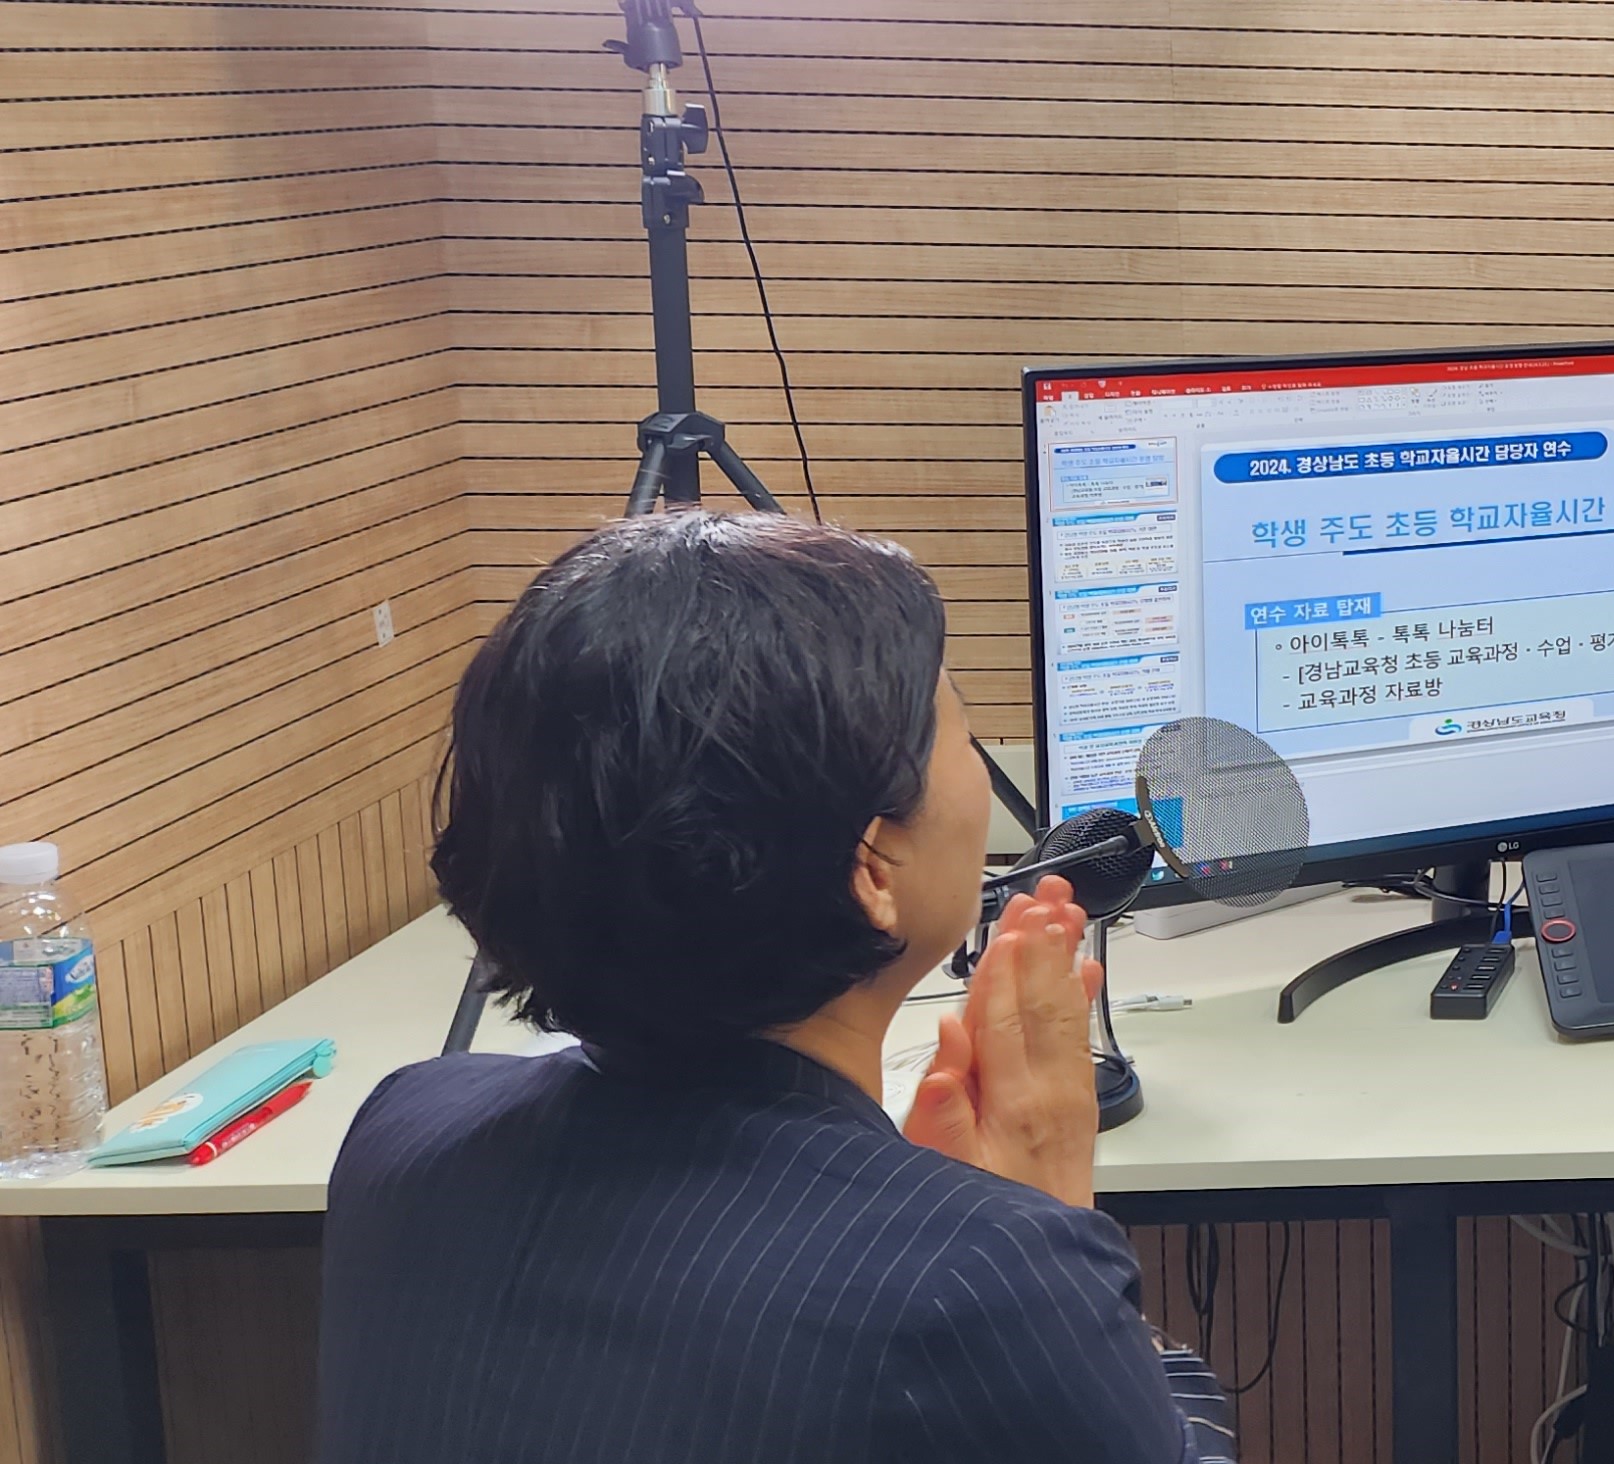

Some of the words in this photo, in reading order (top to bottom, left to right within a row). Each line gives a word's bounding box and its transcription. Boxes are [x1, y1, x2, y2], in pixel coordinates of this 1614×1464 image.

[1250, 459, 1291, 476] 2024.
[1296, 454, 1359, 474] 경상남도
[1364, 451, 1395, 468] 초등
[1401, 445, 1490, 467] 학교자율시간
[1495, 442, 1539, 461] 담당자
[1543, 440, 1572, 458] 연수
[1252, 519, 1306, 548] 학생
[1320, 514, 1373, 544] 주도
[1386, 509, 1438, 537] 초등
[1450, 497, 1605, 533] 학교자율시간
[1251, 606, 1286, 625] 연수
[1294, 602, 1329, 621] 자료
[1336, 597, 1371, 616] 탑재
[1290, 629, 1369, 654] 아이톡톡
[1392, 623, 1430, 643] 톡톡
[1438, 616, 1493, 638] 나눔터
[1298, 655, 1398, 685] [경남교육청
[1404, 651, 1441, 670] 초등
[1447, 642, 1518, 665] 교육과정
[1537, 636, 1571, 657] 수업
[1298, 685, 1377, 710] 교육과정
[1385, 678, 1443, 701] 자료방
[1466, 710, 1566, 730] 경상남도교육청
[1508, 841, 1520, 850] LG
